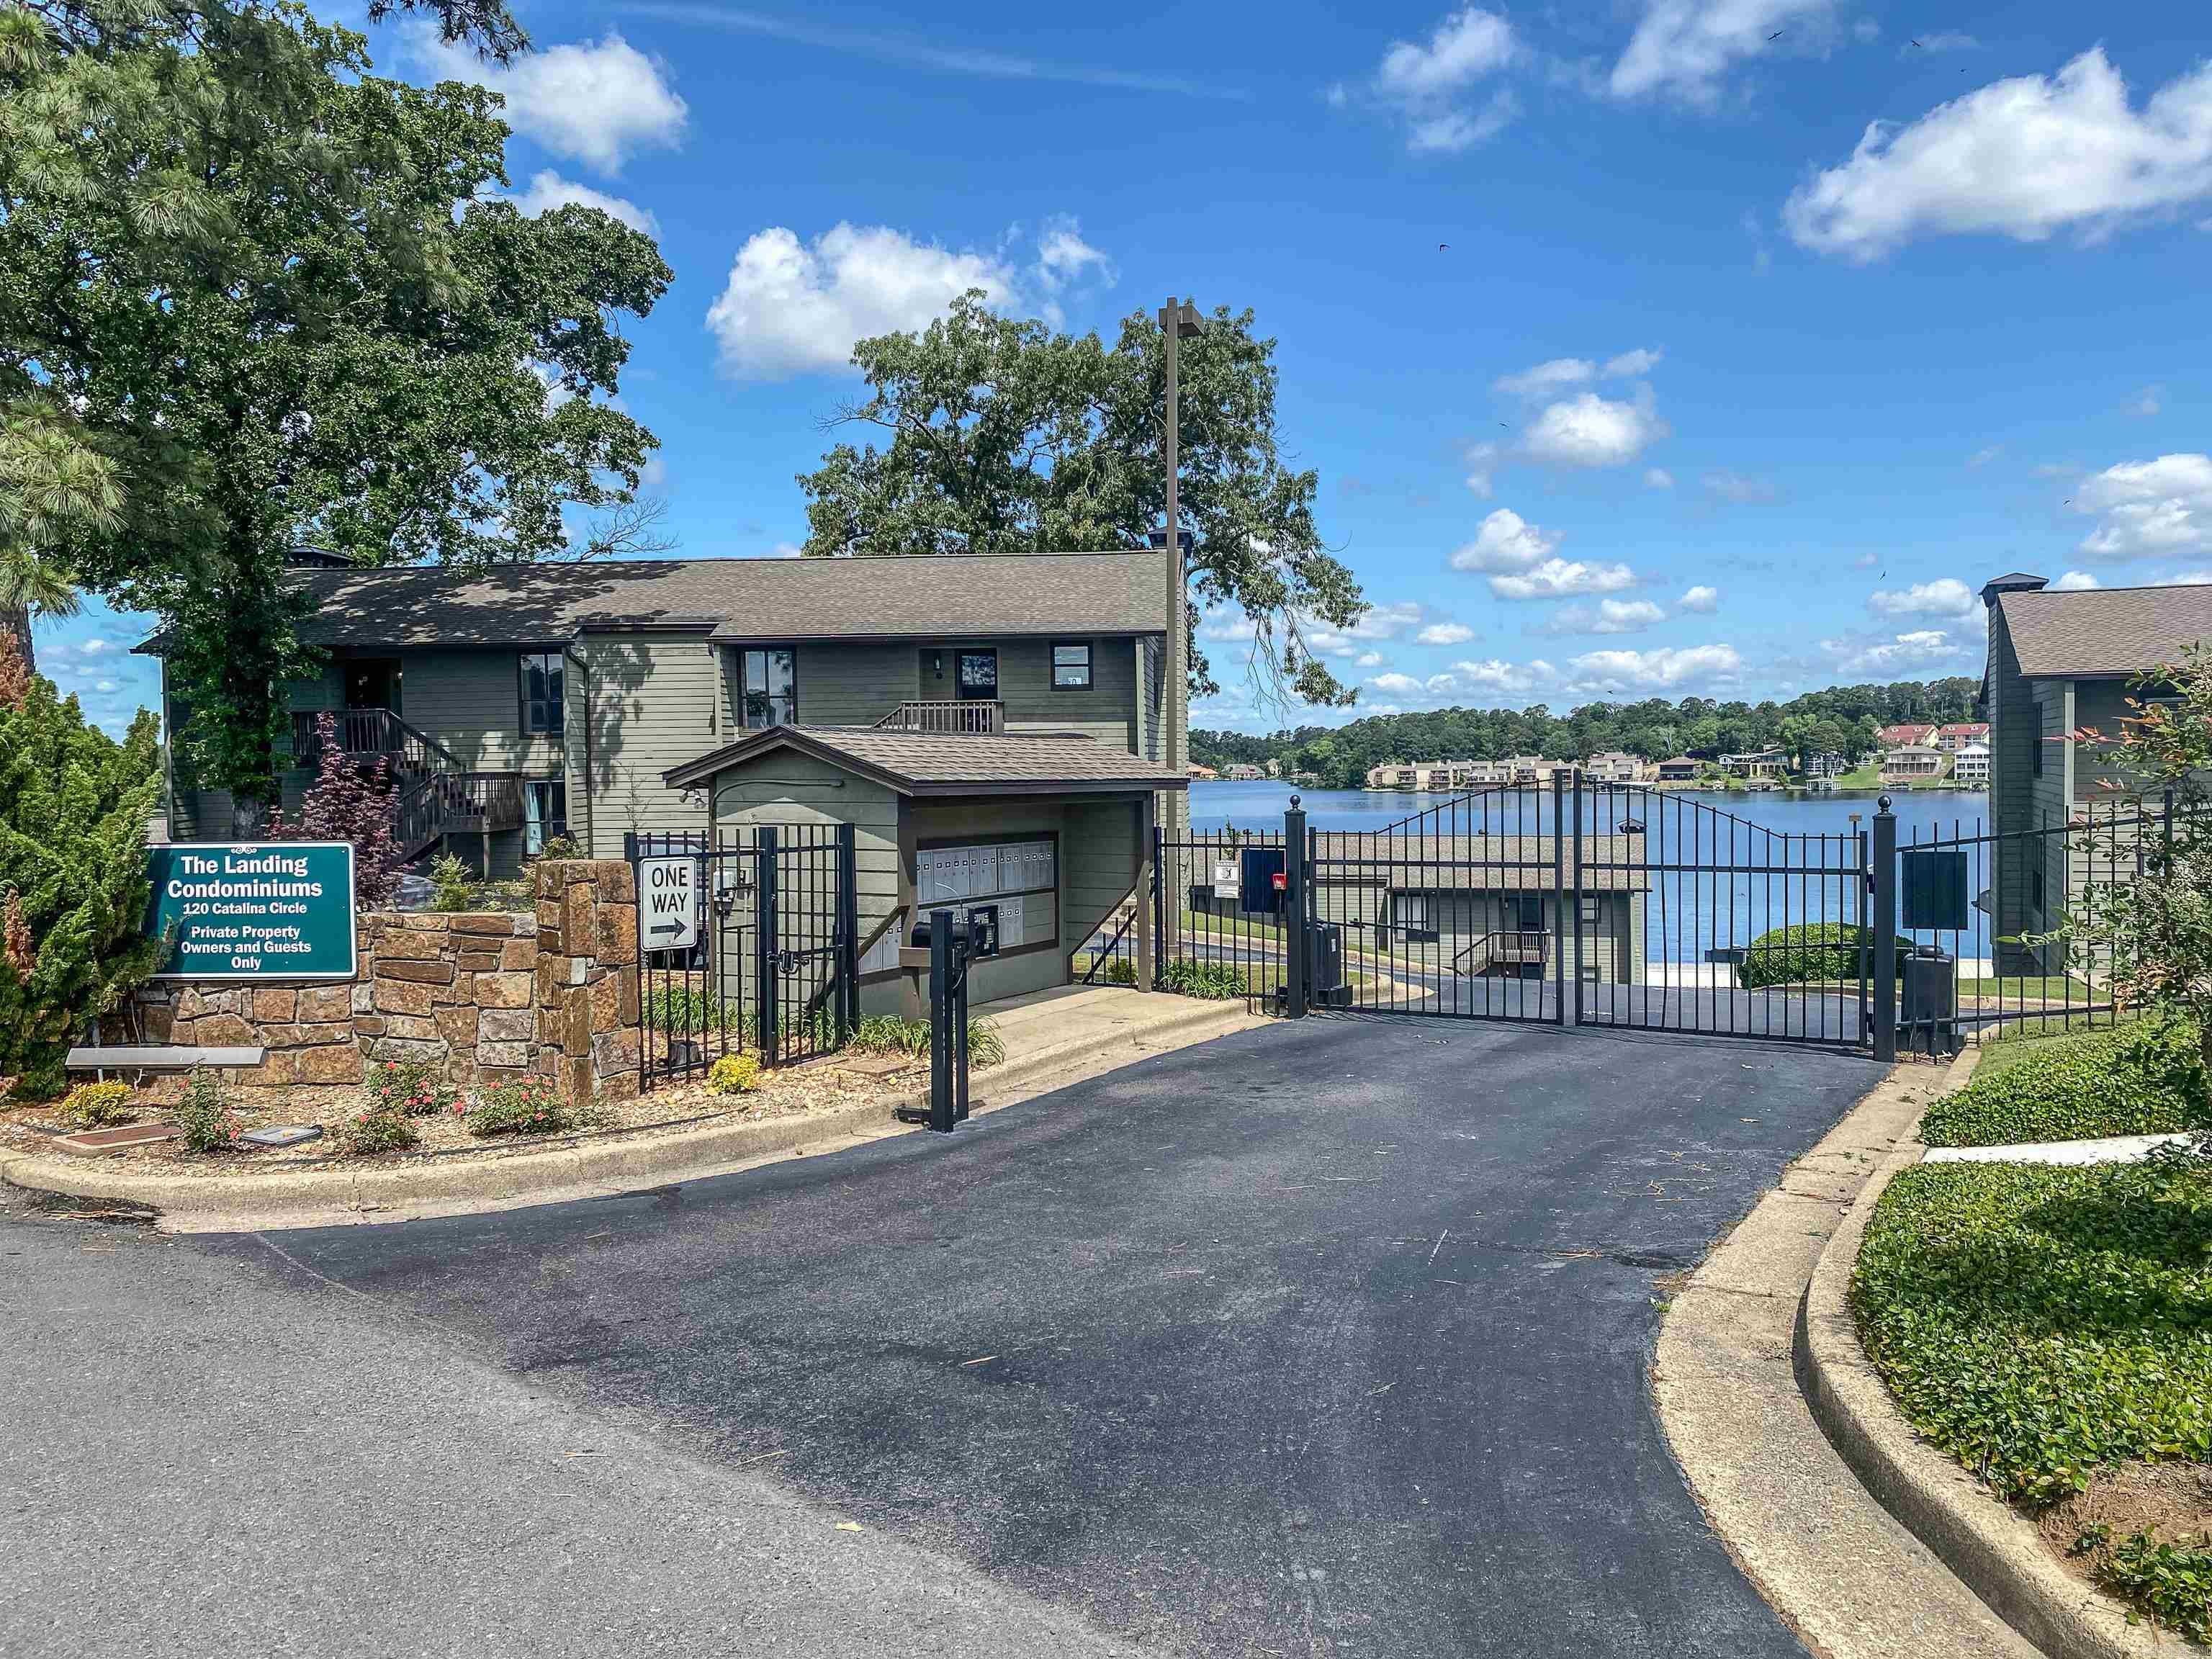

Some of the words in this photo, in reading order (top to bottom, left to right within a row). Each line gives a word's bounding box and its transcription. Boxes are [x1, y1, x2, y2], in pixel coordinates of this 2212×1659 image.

[181, 855, 218, 873] The
[224, 855, 308, 876] Landing
[652, 866, 688, 887] ONE
[167, 878, 323, 898] Condominiums
[183, 903, 209, 914] 120
[212, 902, 266, 914] Catalina
[269, 902, 307, 914] Circle
[652, 892, 688, 913] WAY
[191, 926, 238, 938] Private
[242, 925, 300, 940] Property
[181, 941, 232, 953] Owners
[235, 941, 261, 953] and
[264, 941, 312, 953] Guests
[231, 956, 261, 970] Only
